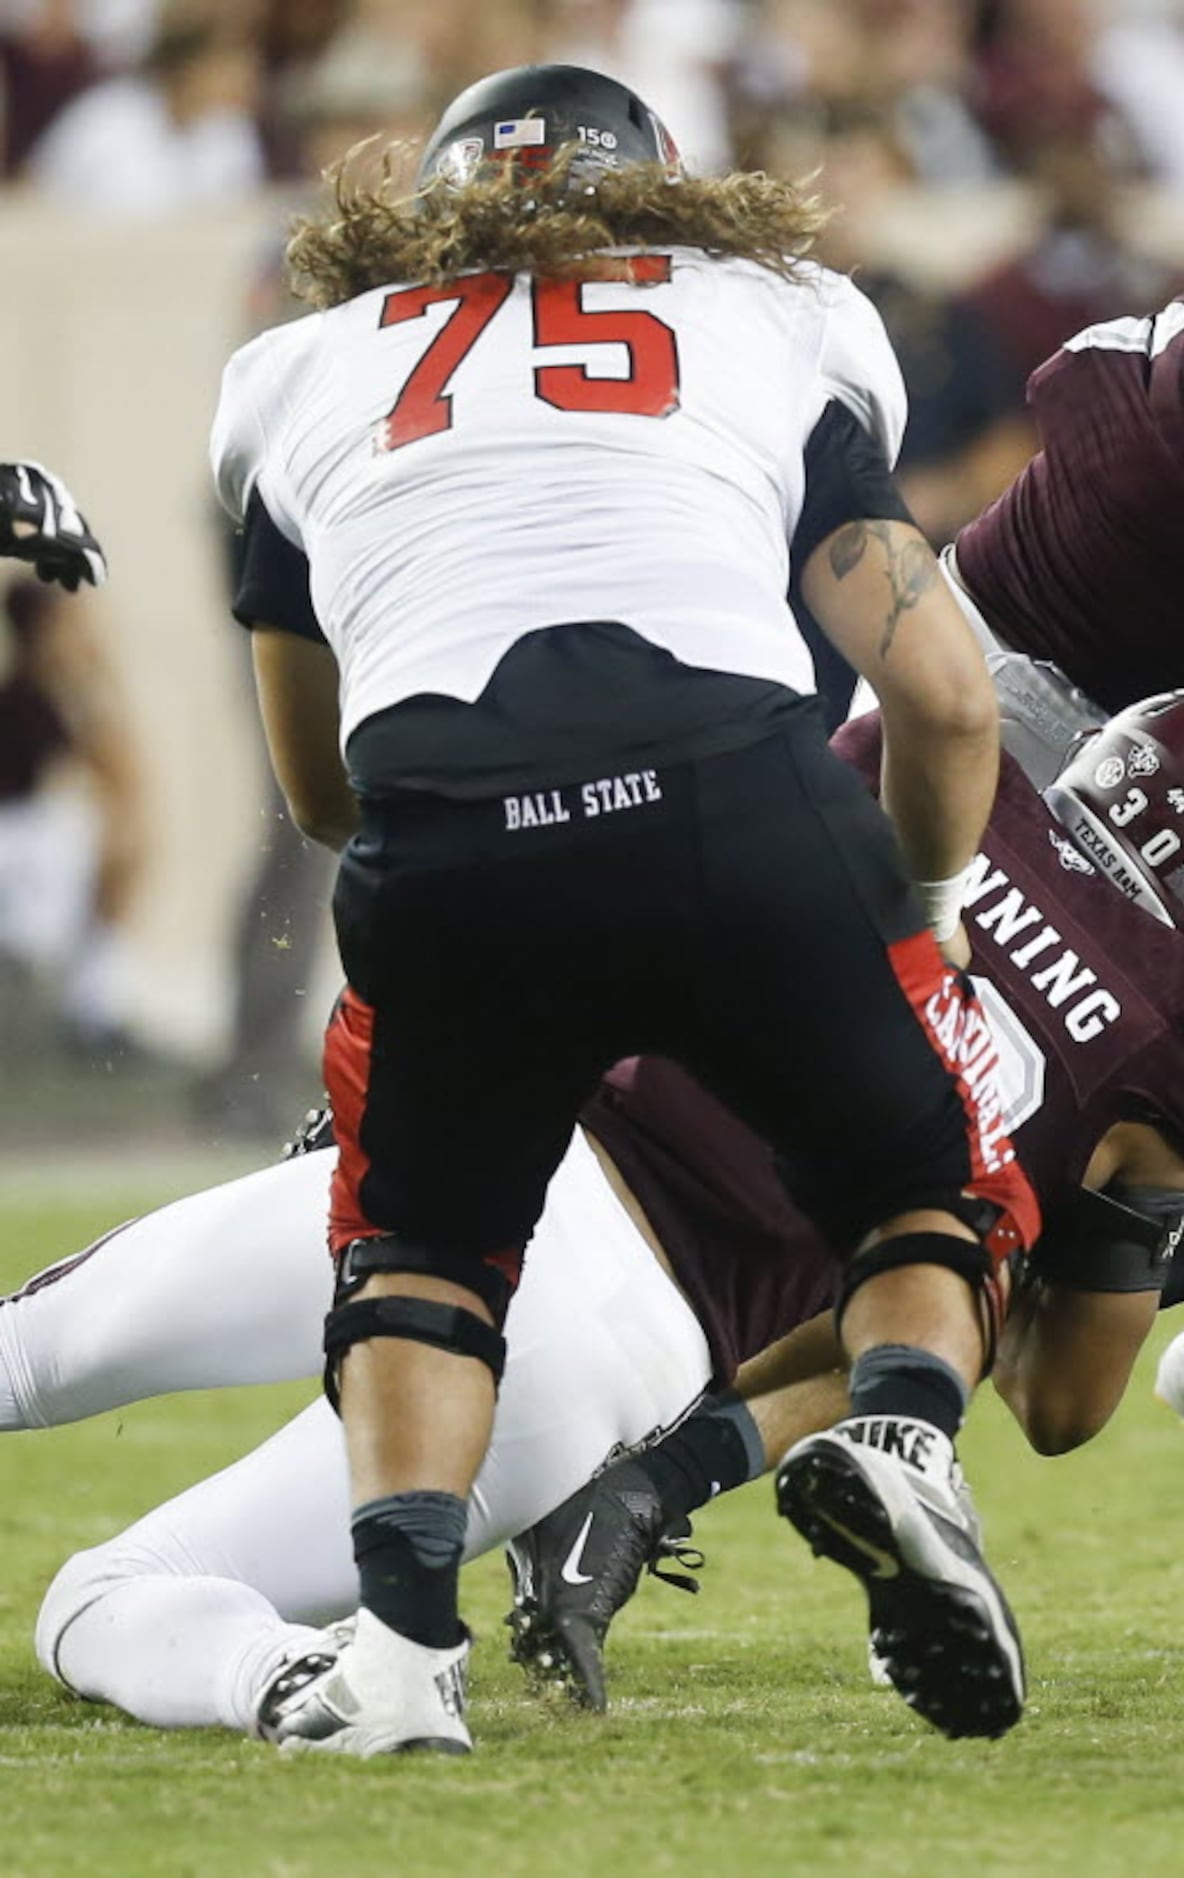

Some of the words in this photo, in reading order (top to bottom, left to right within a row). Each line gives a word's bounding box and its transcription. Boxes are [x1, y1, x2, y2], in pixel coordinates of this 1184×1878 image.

[376, 254, 681, 451] 75
[504, 790, 570, 830] BALL
[582, 769, 662, 818] STATE
[1074, 818, 1118, 869] TEXAS
[835, 1420, 938, 1472] NIKE
